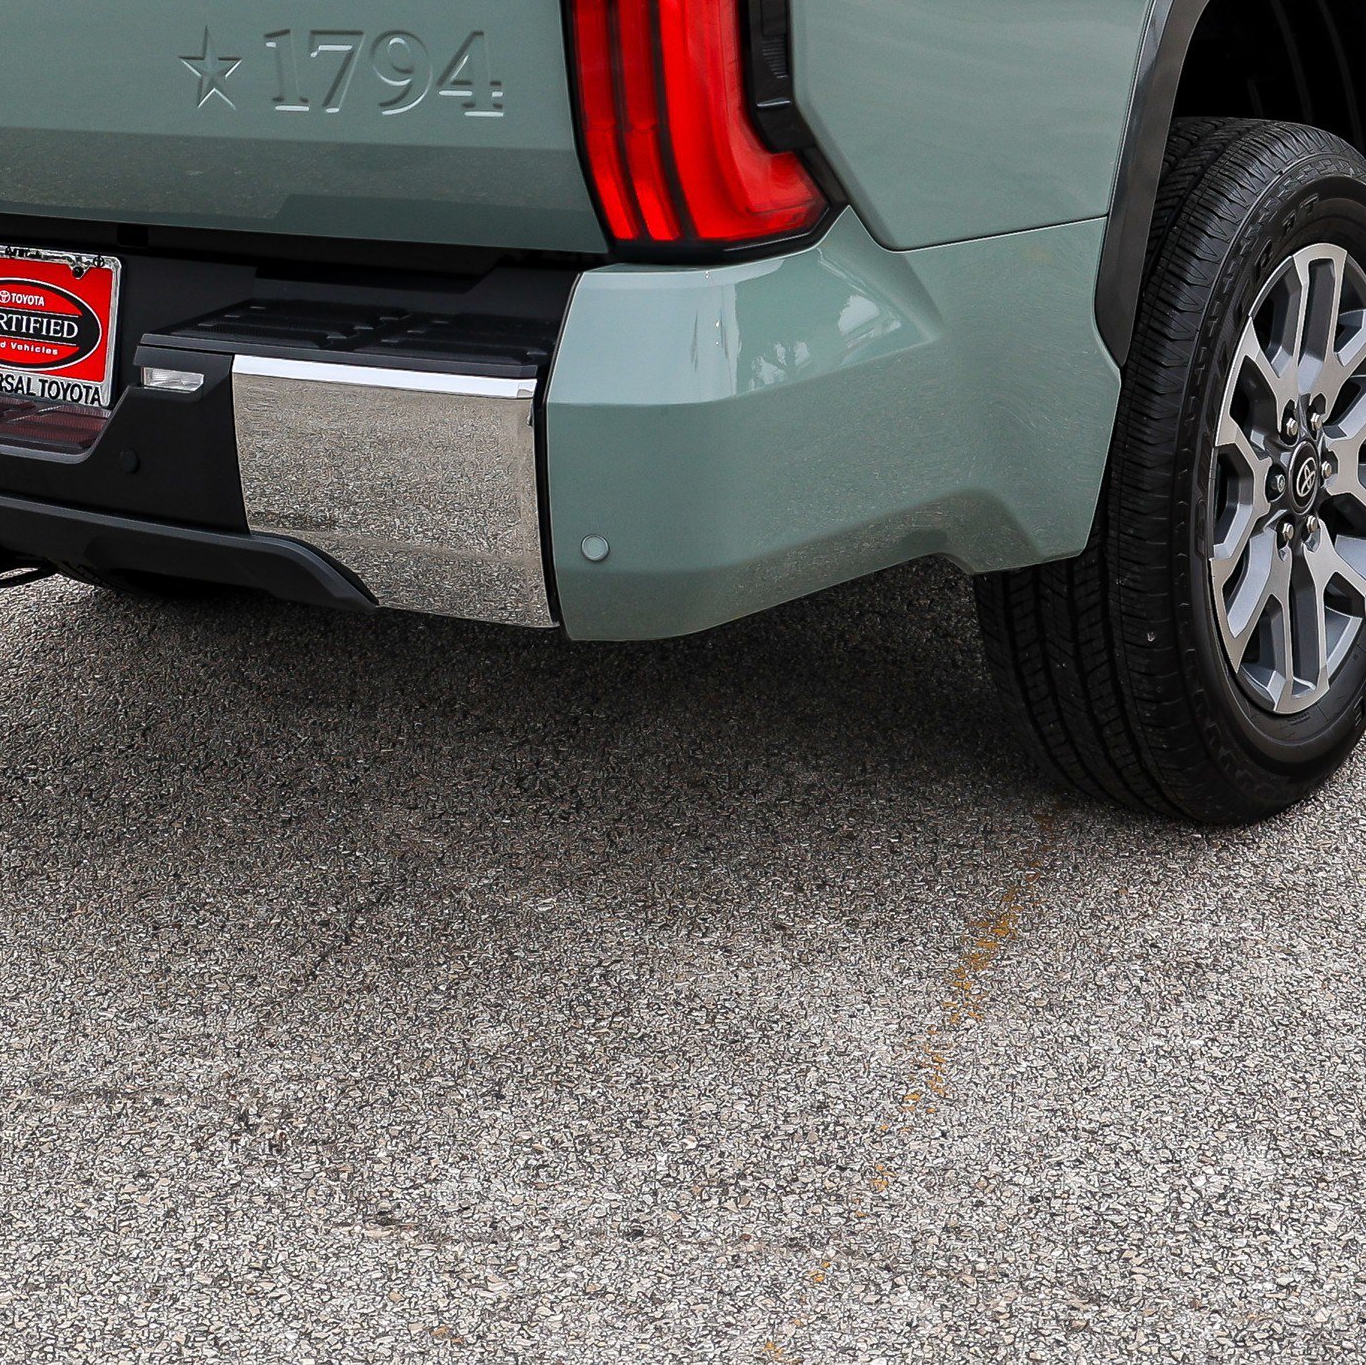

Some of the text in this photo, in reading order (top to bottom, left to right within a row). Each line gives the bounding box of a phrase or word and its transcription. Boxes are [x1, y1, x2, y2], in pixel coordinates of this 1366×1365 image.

[263, 29, 505, 118] 1794
[11, 292, 45, 307] TOYOTA
[11, 341, 59, 356] Vehicles
[38, 378, 103, 407] TOYOTA
